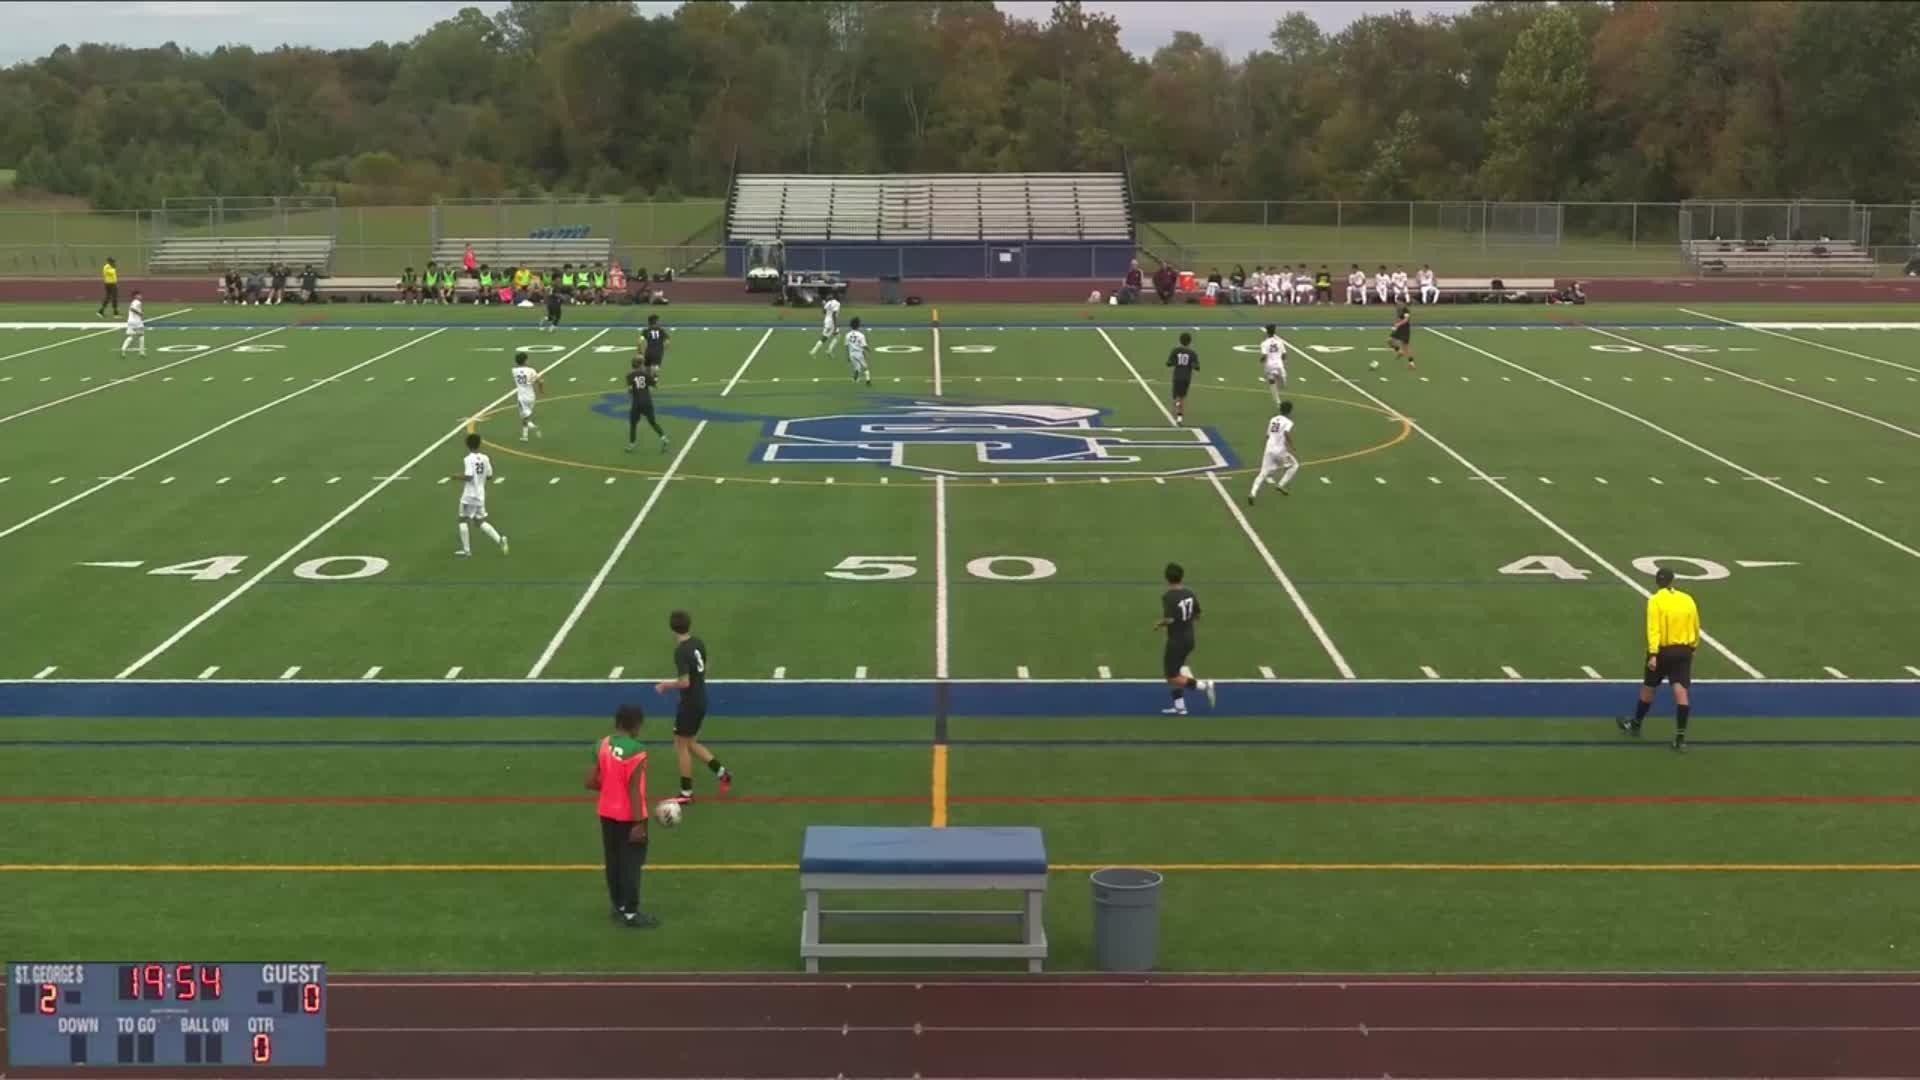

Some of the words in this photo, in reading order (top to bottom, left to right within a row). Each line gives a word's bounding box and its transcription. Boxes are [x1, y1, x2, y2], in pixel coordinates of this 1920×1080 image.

[650, 329, 660, 339] 11
[1177, 353, 1189, 365] 10
[1178, 598, 1193, 620] 17
